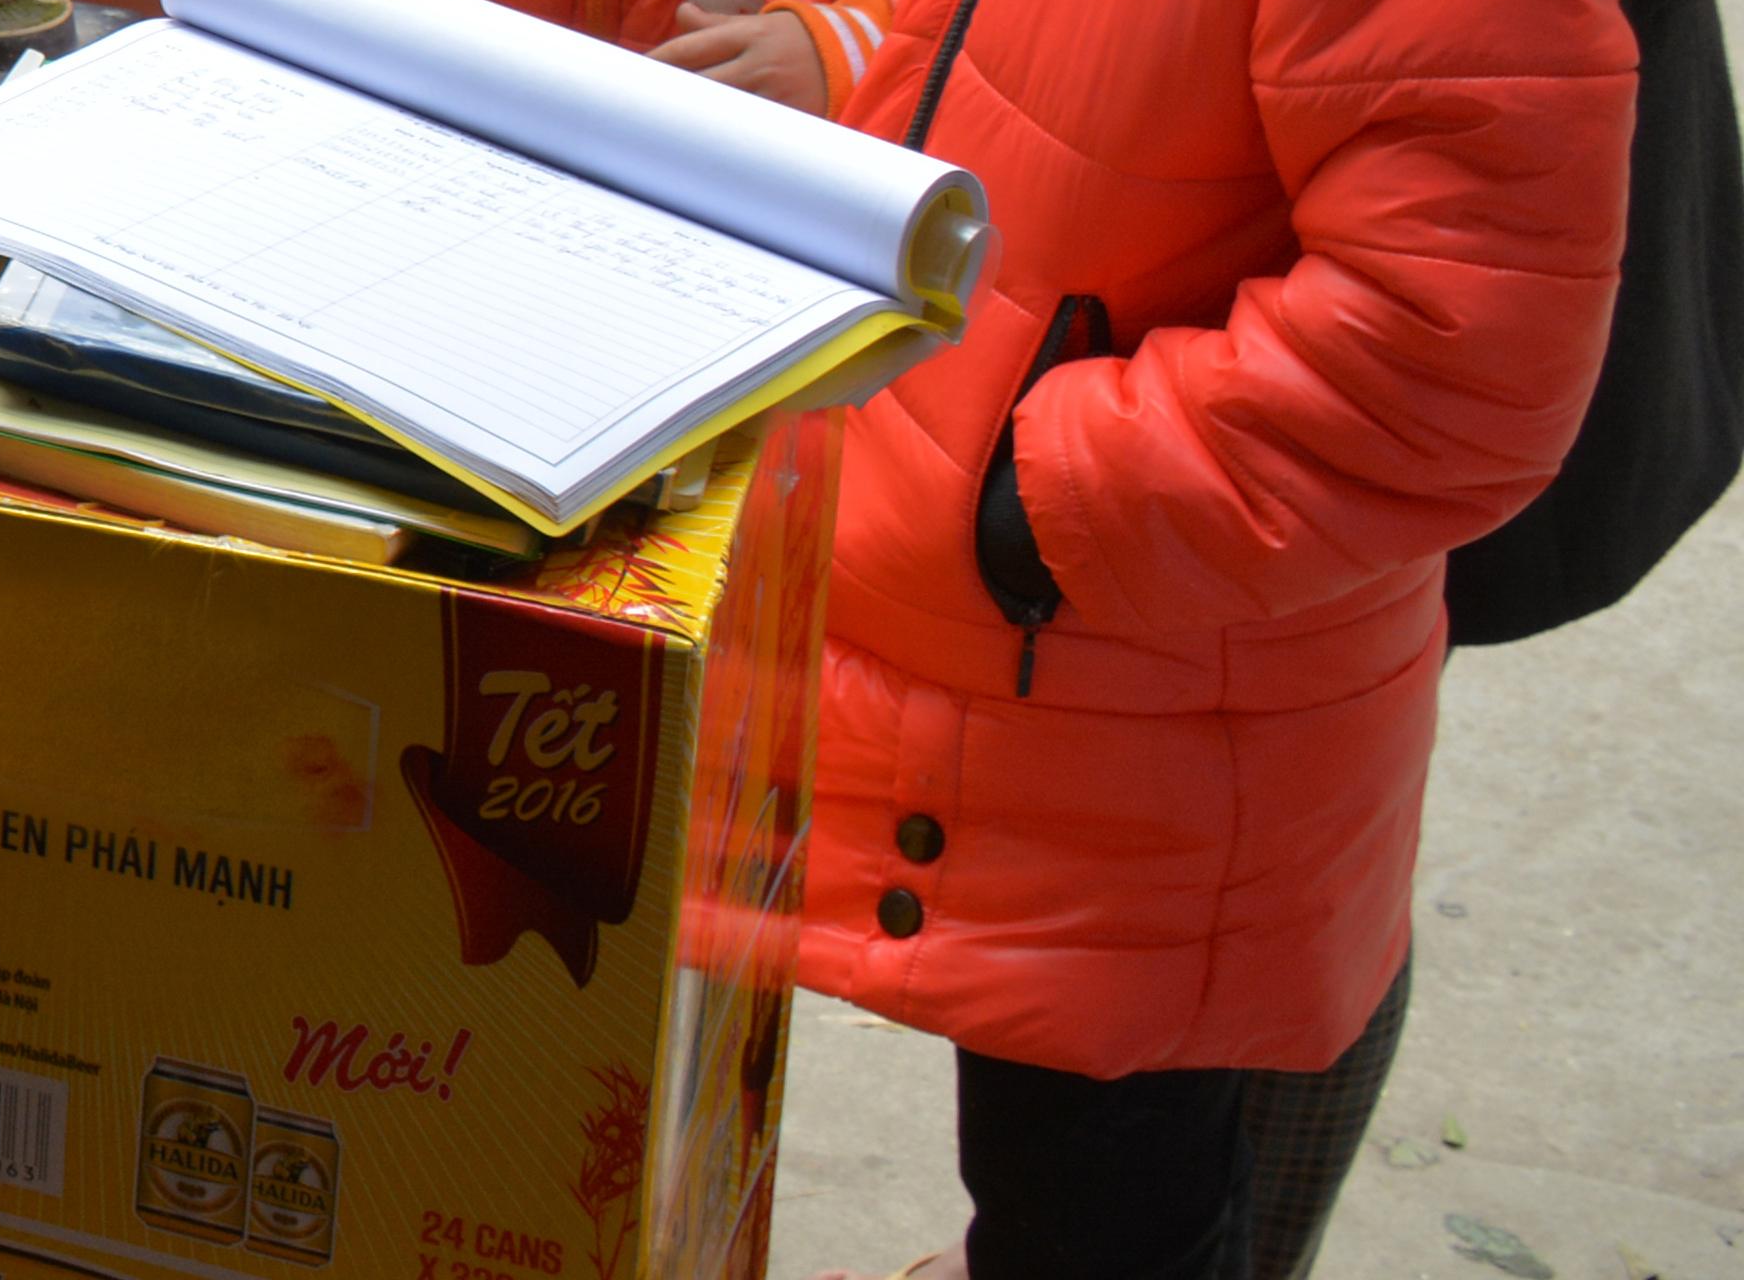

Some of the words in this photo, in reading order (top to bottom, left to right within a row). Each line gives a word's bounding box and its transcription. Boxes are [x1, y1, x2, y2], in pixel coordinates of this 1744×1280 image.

[478, 670, 619, 771] Tết
[479, 775, 609, 825] 2016
[64, 823, 157, 881] PHÁI
[173, 845, 294, 911] MẠNH
[13, 970, 52, 991] đoàn
[14, 993, 39, 1014] Nội
[283, 1015, 472, 1103] Mới!
[148, 1141, 239, 1182] HALIDA
[420, 1209, 465, 1251] 24
[475, 1223, 564, 1276] CANS
